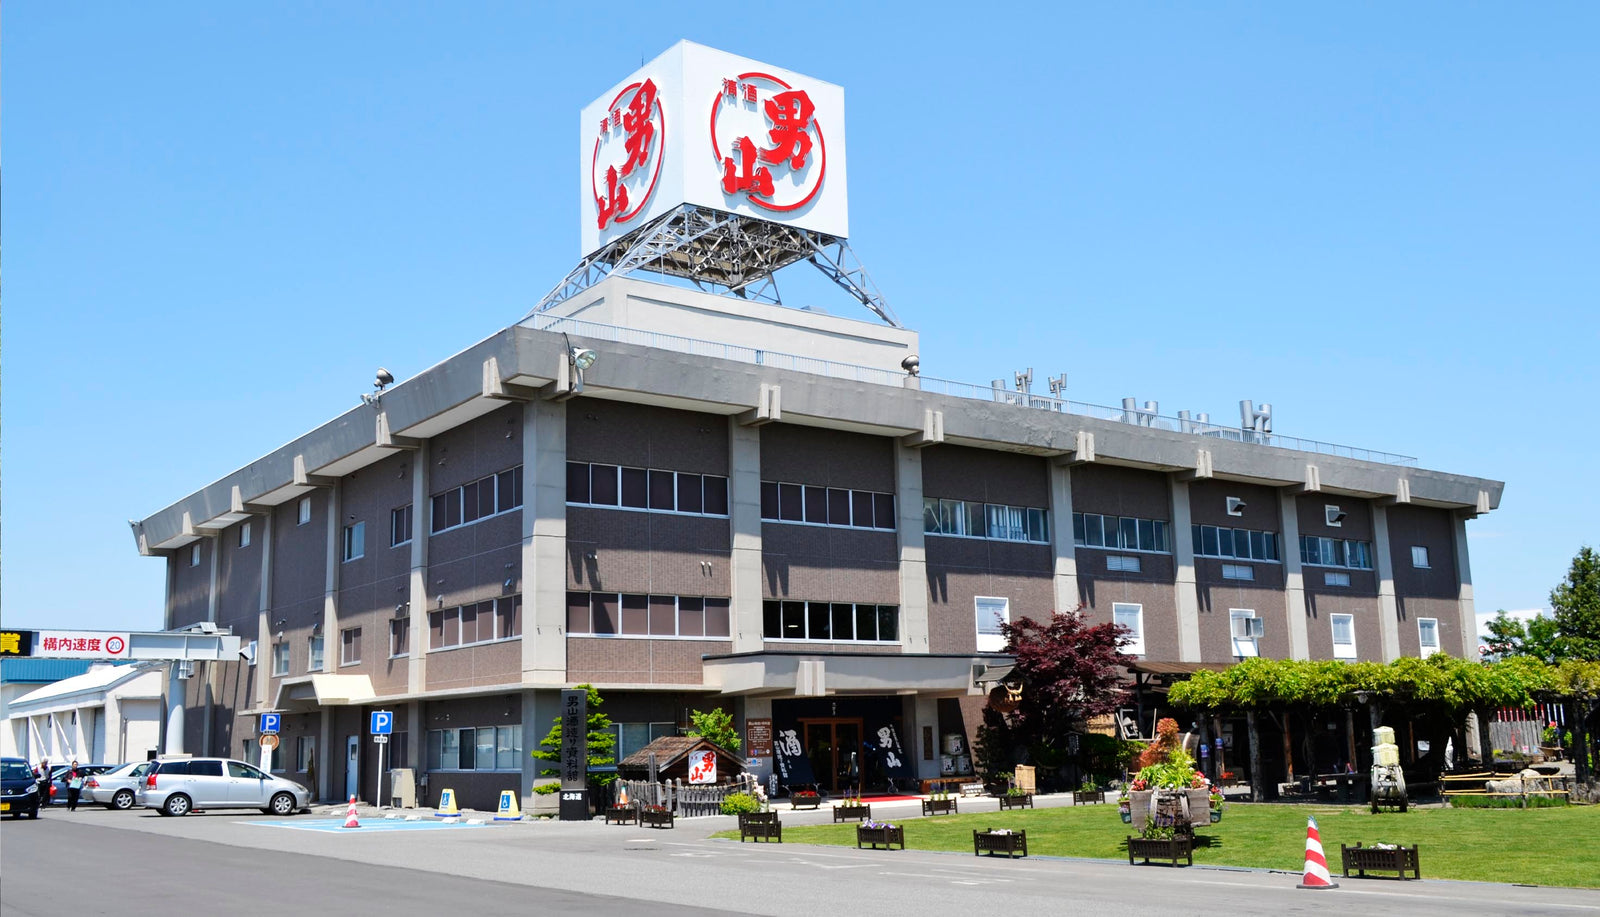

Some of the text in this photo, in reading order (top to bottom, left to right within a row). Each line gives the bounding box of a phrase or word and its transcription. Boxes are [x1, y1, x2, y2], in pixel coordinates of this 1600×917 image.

[721, 77, 757, 103] 清酒
[600, 107, 621, 134] 清酒
[598, 78, 657, 231] 男山
[722, 89, 815, 198] 男山
[43, 637, 102, 651] 構内速度
[109, 640, 121, 650] 20
[265, 715, 277, 730] P
[376, 714, 389, 732] P
[779, 729, 802, 757] 酒
[877, 726, 902, 768] 男山
[690, 751, 716, 782] 男山
[562, 792, 582, 801] 北海道
